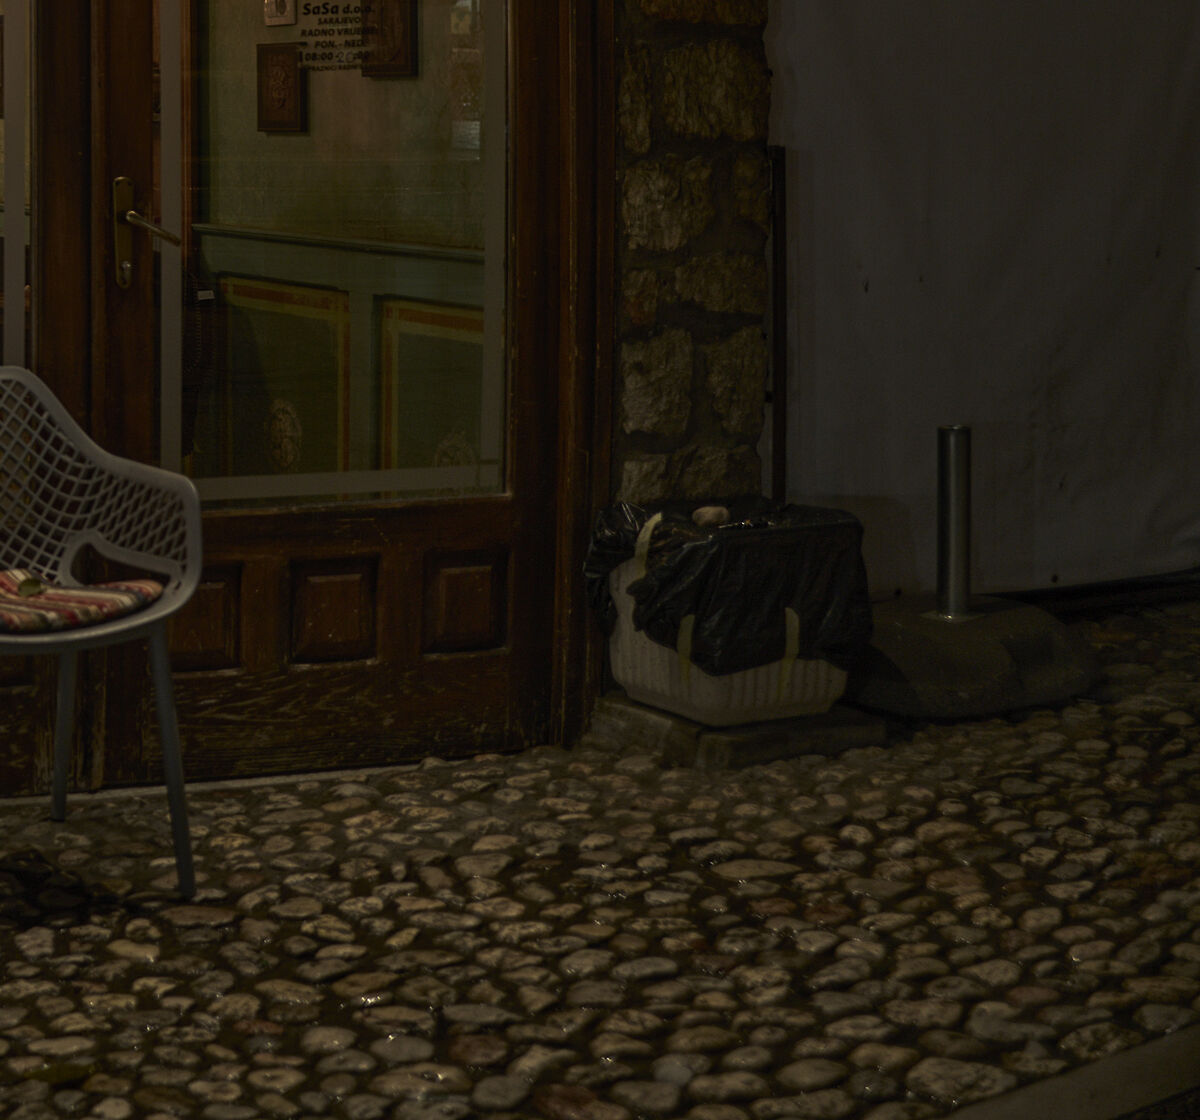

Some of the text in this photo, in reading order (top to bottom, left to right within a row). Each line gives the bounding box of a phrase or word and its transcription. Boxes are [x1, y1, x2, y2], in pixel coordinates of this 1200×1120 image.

[302, 2, 339, 15] SaSa
[317, 16, 362, 25] SARAJEVO
[300, 28, 335, 37] RADNO
